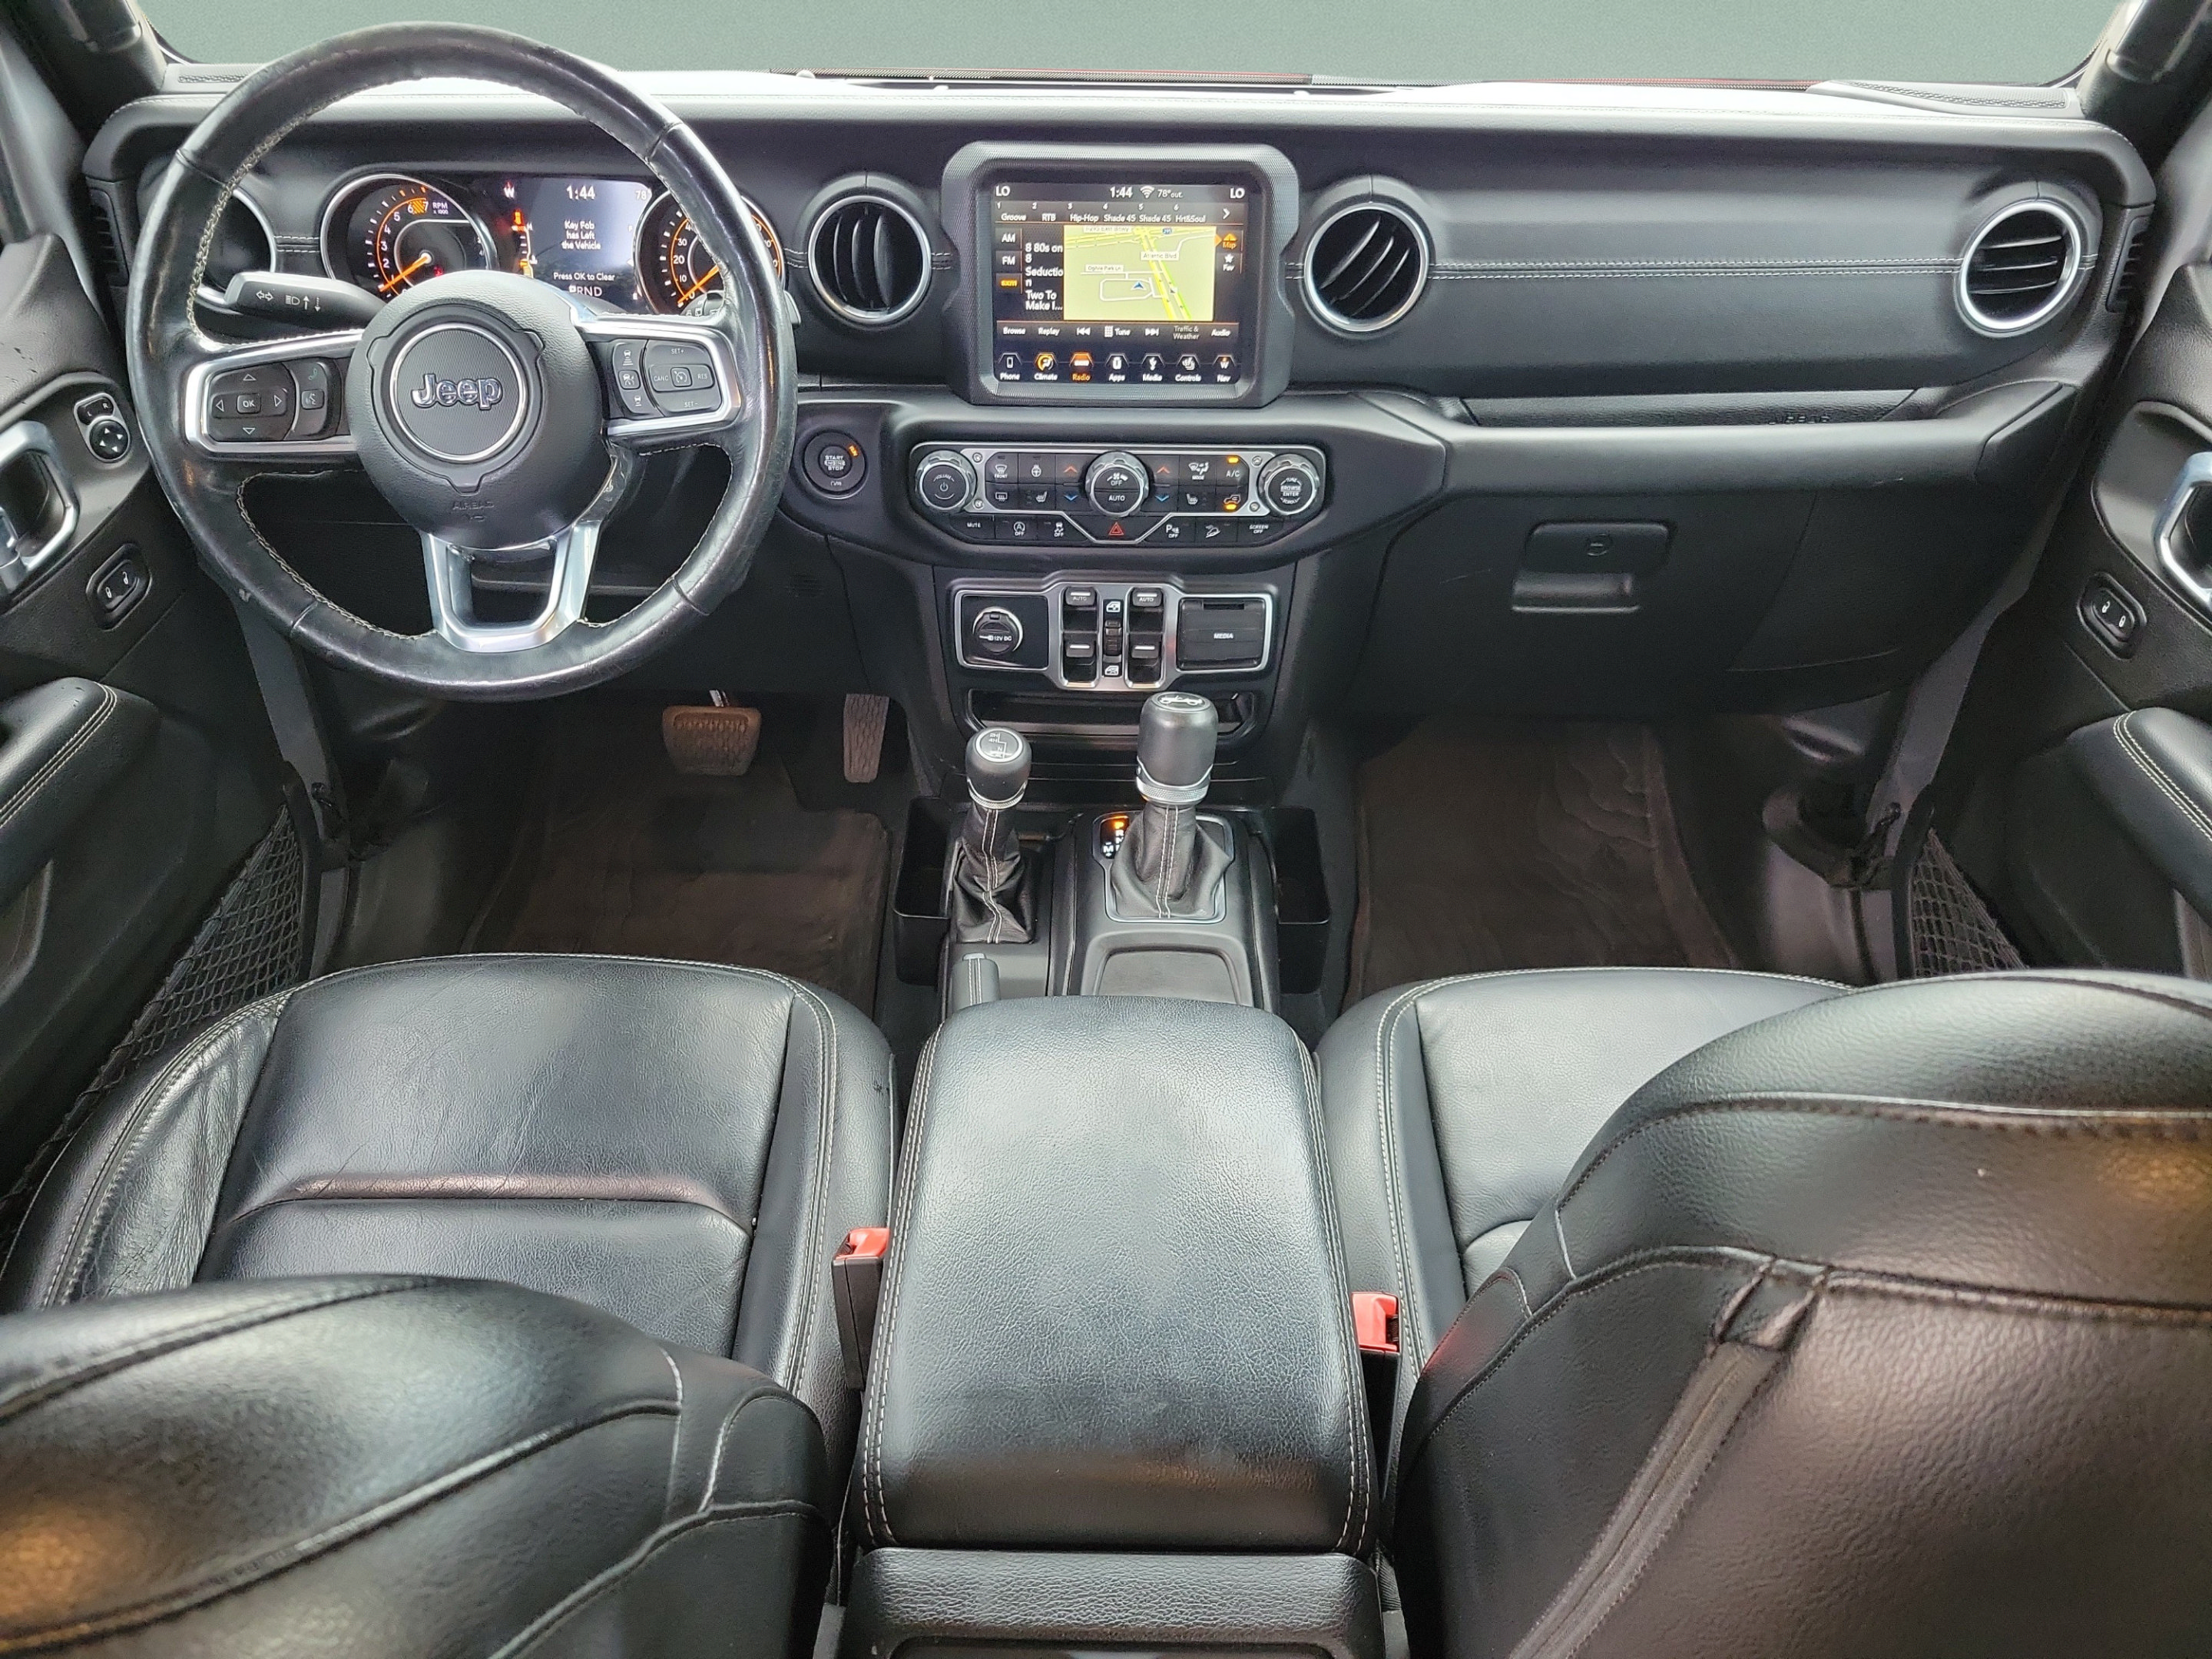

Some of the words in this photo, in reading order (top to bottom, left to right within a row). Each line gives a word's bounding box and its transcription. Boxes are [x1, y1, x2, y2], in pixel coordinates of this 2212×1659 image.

[567, 185, 595, 200] 1:44
[995, 185, 1011, 197] LO
[1110, 186, 1134, 198] 1:44
[1230, 187, 1245, 199] LO
[407, 204, 413, 214] 6
[423, 201, 429, 213] 7
[393, 212, 400, 221] 5
[1001, 213, 1027, 221] Groove
[1041, 213, 1057, 221] RTB
[1070, 214, 1099, 223] Hip-Hop
[1103, 214, 1125, 222] Shade
[1175, 214, 1207, 223] Hrt&Soul
[384, 224, 391, 234] 4
[565, 221, 579, 230] Key
[580, 220, 594, 230] Fob
[566, 231, 579, 240] has
[580, 231, 595, 240] Left
[1002, 233, 1016, 243] AM
[381, 240, 388, 251] 3
[561, 240, 574, 250] the
[575, 240, 601, 250] Vehicle
[1025, 242, 1032, 253] 8
[1034, 243, 1049, 253] 80s
[673, 255, 684, 264] 20
[1002, 256, 1016, 265] FM
[1025, 253, 1032, 263] 8
[383, 259, 390, 268] 2
[1025, 266, 1064, 276] Seductio
[553, 272, 572, 280] Press
[596, 272, 615, 281] Clear
[1025, 279, 1032, 287] n
[1025, 290, 1044, 300] Two
[1045, 290, 1057, 300] To
[1025, 300, 1051, 310] Make
[1003, 326, 1026, 335] Browse
[1038, 327, 1060, 336] Replay
[1114, 328, 1131, 336] Tune
[1108, 374, 1125, 382] Apps
[1174, 374, 1202, 382] Controls
[410, 373, 503, 411] Jeep
[242, 399, 256, 408] OK
